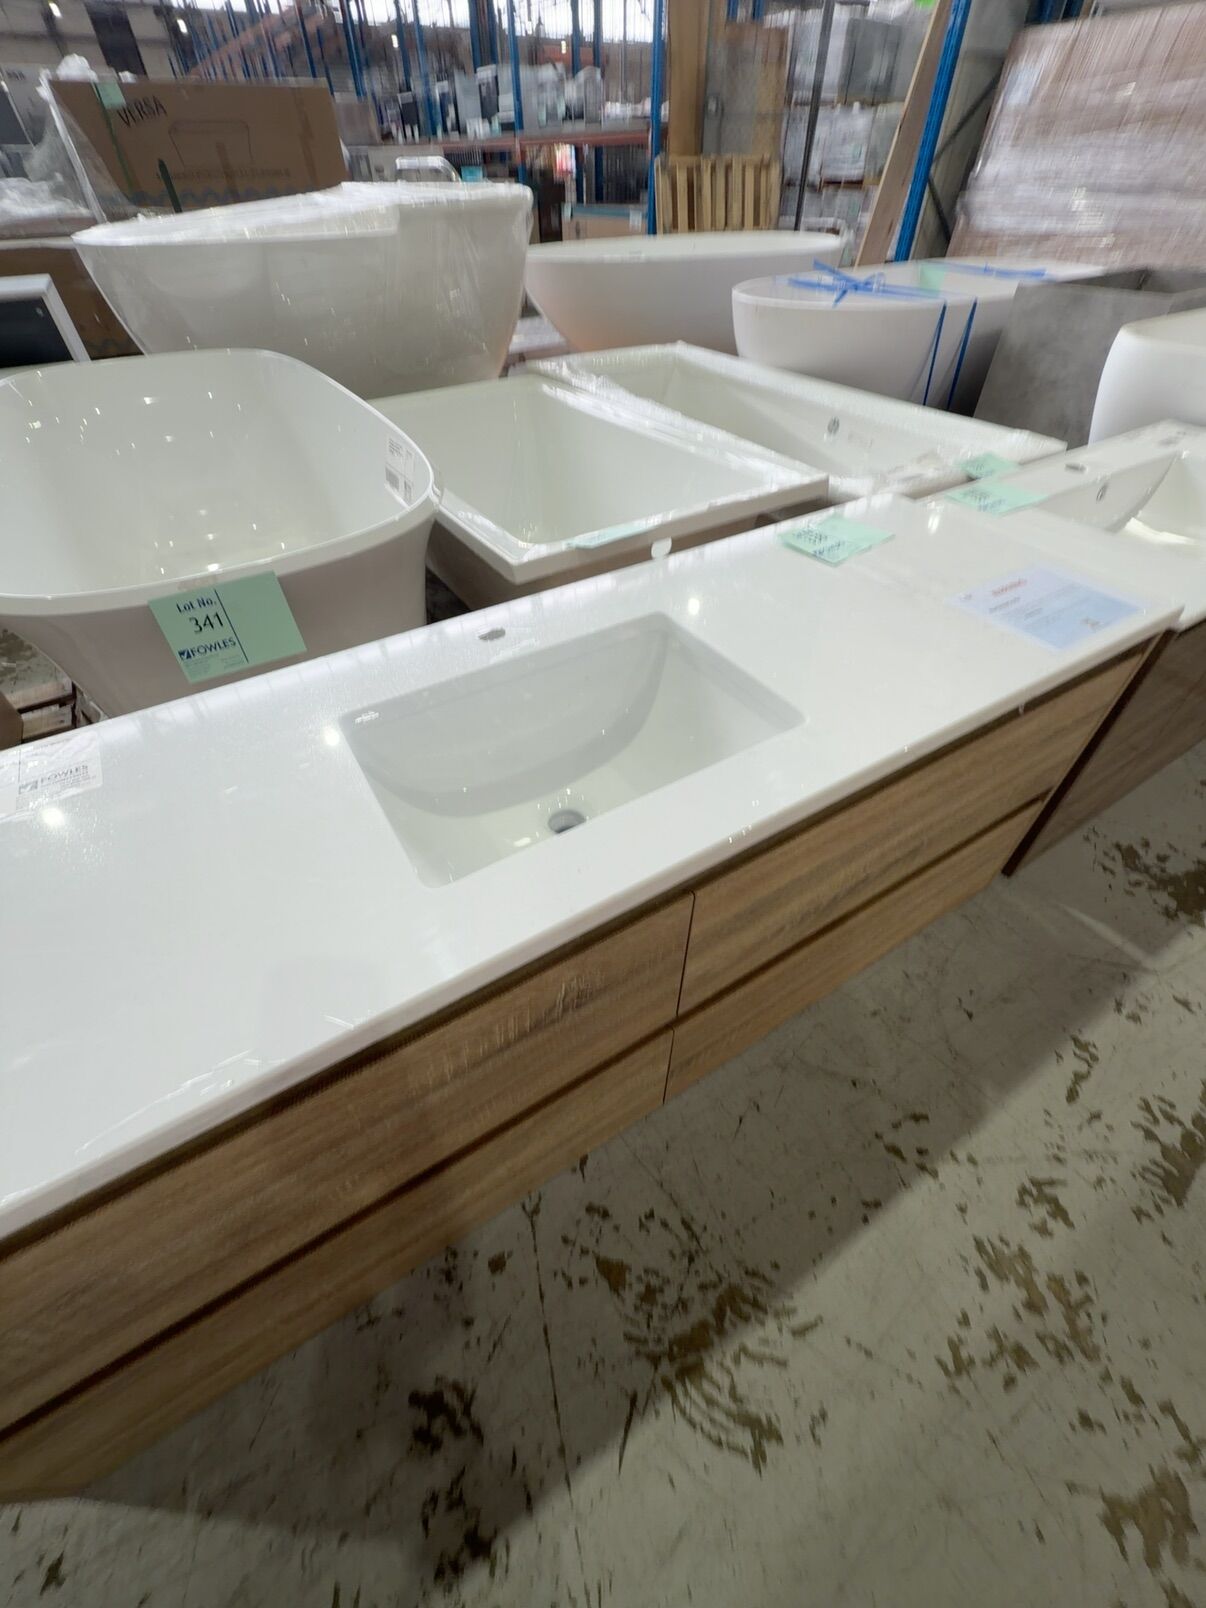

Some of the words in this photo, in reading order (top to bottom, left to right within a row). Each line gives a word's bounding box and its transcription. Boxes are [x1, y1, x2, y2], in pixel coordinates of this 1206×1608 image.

[116, 95, 168, 127] VERSA
[176, 601, 195, 613] Lot
[197, 597, 217, 608] No.
[189, 612, 223, 634] 341
[191, 637, 236, 657] FOWLES
